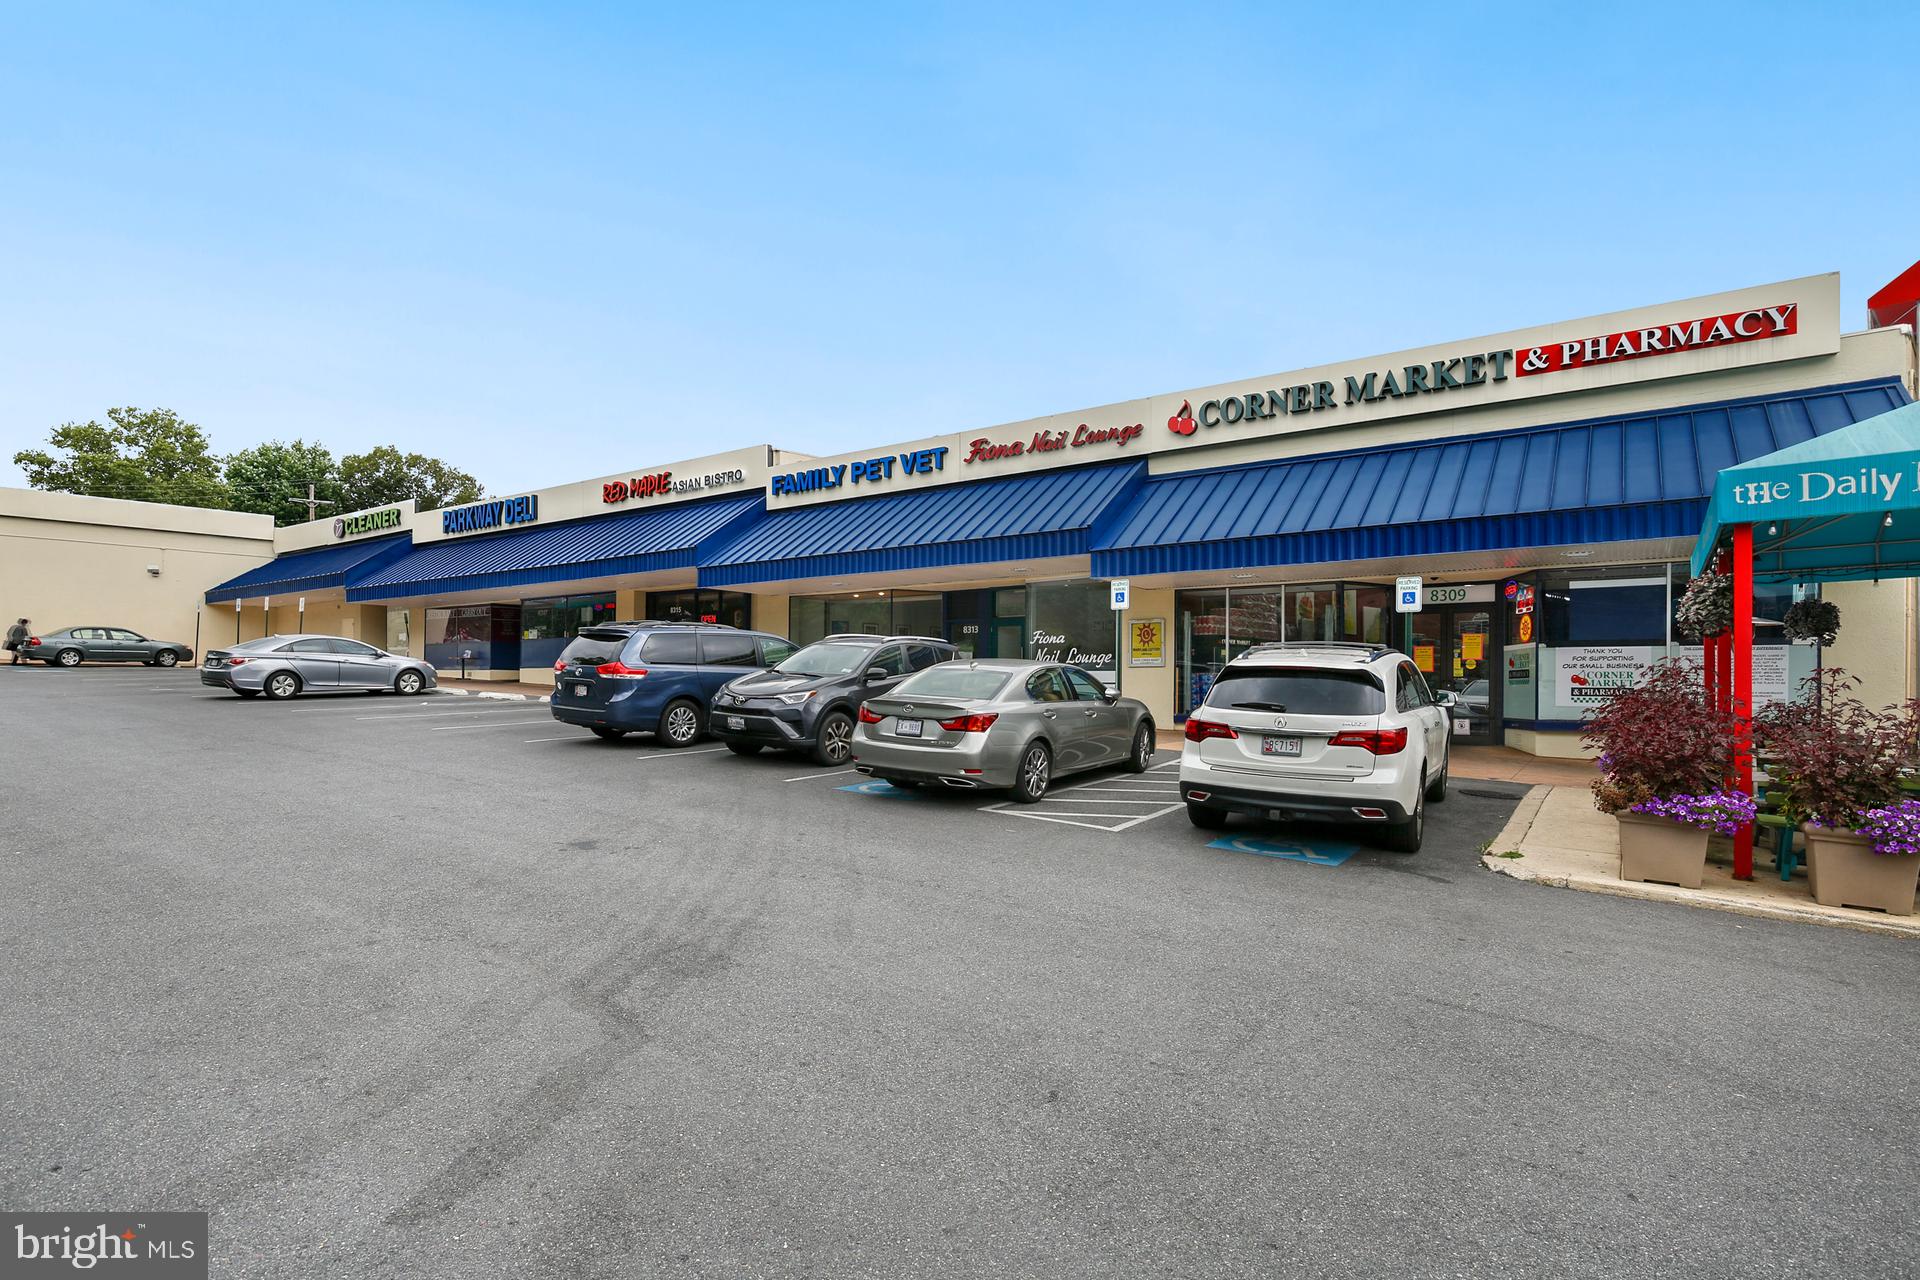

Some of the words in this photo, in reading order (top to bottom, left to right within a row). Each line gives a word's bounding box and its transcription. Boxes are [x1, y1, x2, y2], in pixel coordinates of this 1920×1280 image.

[1199, 380, 1337, 428] CORNER
[1344, 349, 1513, 405] MARKET
[1522, 347, 1549, 372] &
[1560, 304, 1797, 366] PHARMACY
[963, 437, 1024, 464] Fiona
[1027, 430, 1070, 454] Nail
[1070, 423, 1144, 449] Lounge
[603, 481, 629, 503] RED
[630, 471, 672, 498] MAPLE
[672, 477, 704, 492] ASIAN
[704, 469, 743, 486] BISTRO
[772, 464, 847, 496] FAMILY
[851, 455, 896, 483] PET
[900, 447, 949, 475] VET
[1798, 468, 1902, 501] Daily
[344, 508, 400, 534] CLEANER
[443, 501, 503, 534] PARKWAY
[505, 494, 538, 524] DELI
[1430, 588, 1466, 602] 8309
[963, 625, 979, 634] 8313
[1030, 630, 1065, 645] Fiona
[1035, 648, 1059, 664] Nail
[1066, 648, 1112, 668] Lounge
[1586, 671, 1634, 679] CORNER
